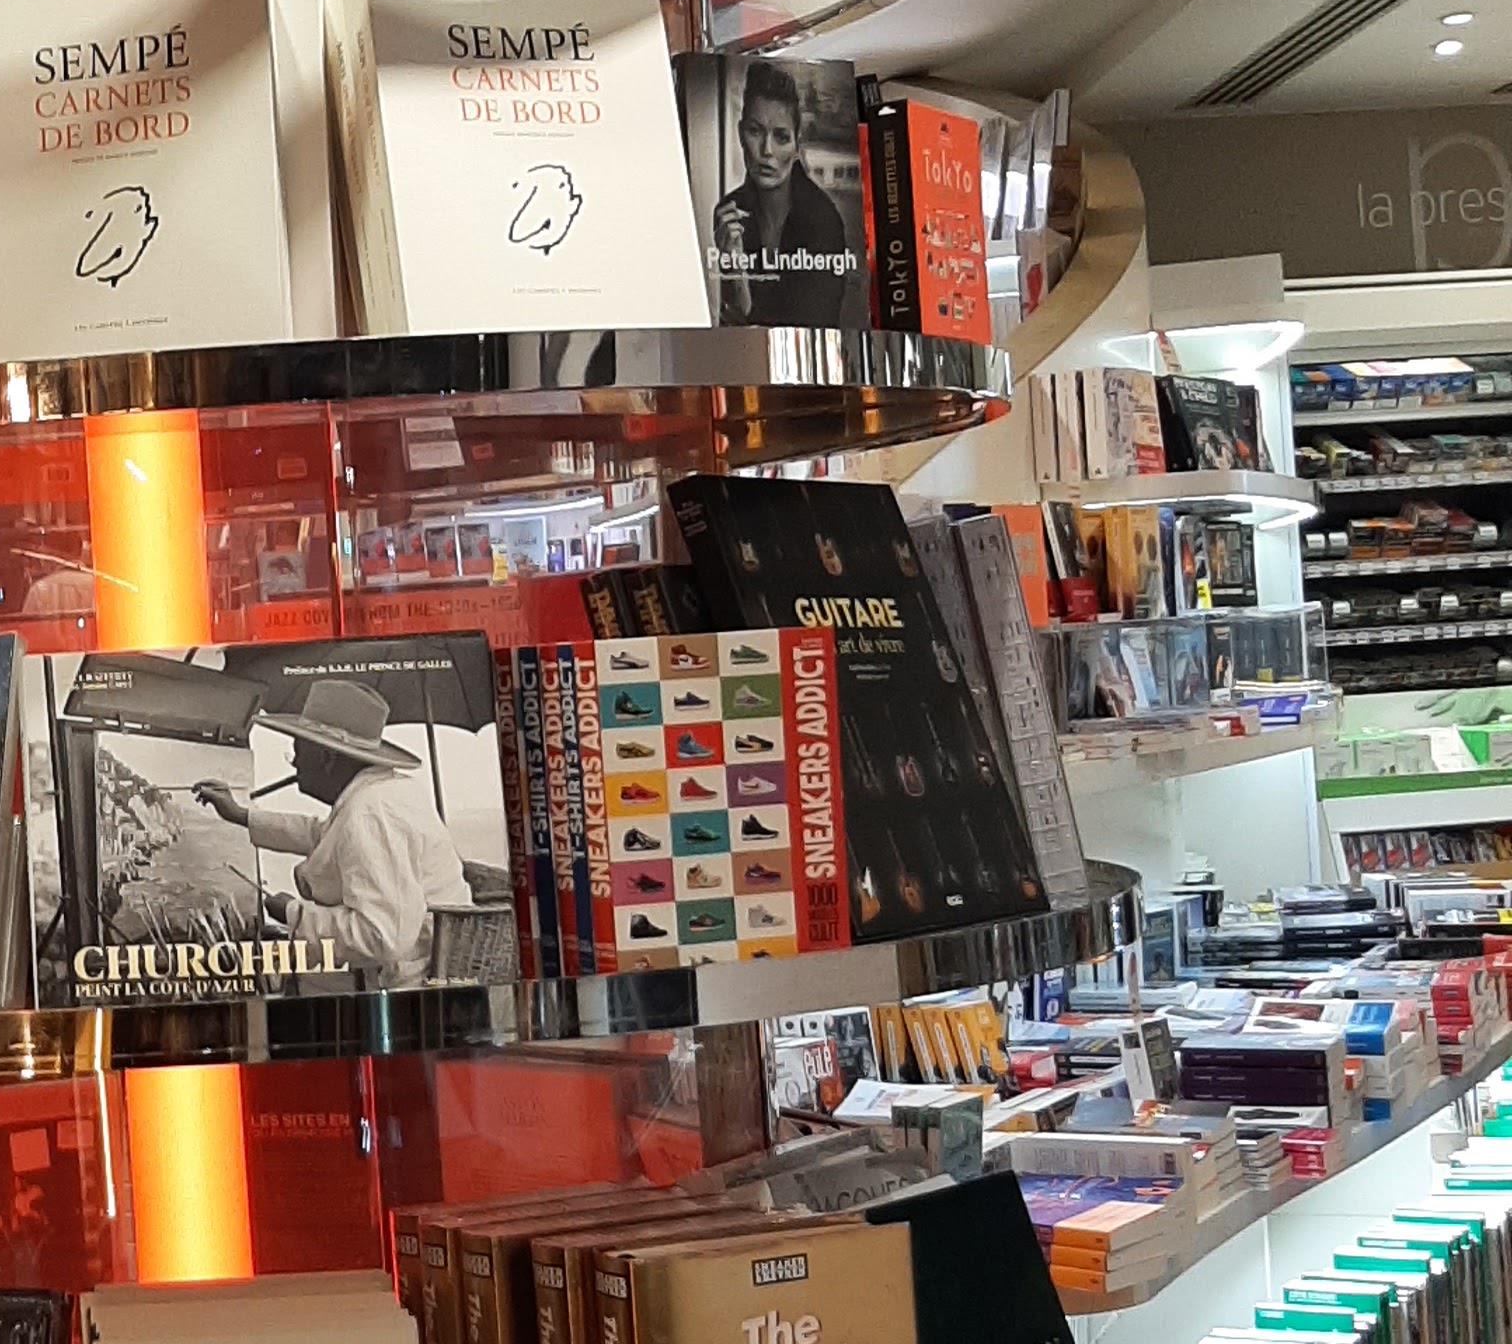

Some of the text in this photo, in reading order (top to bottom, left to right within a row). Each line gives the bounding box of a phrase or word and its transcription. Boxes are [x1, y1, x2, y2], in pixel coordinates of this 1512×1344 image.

[34, 25, 190, 85] SEMPÉ
[448, 22, 596, 63] SEMPÉ
[35, 75, 192, 120] CARNETS
[451, 65, 600, 94] CARNETS
[39, 111, 190, 154] DE BORD
[460, 97, 601, 125] DE BORD
[1355, 183, 1393, 228] la
[708, 246, 857, 277] Peter Lindbergh
[794, 596, 904, 629] GUITARE
[792, 647, 830, 738] ADDICT
[494, 661, 529, 889] SNEAKERS ADDICT
[519, 658, 551, 856] T-SHIRTS ADDICT
[540, 657, 575, 891] SNEAKERS ADDICT
[558, 656, 586, 858] T-SHIRTS ADDICT
[573, 655, 612, 899] SNEAKERS ADDICT
[797, 742, 836, 879] SNEAKERS
[73, 937, 351, 982] CHURCHILL
[75, 982, 122, 999] PEINT
[125, 981, 148, 997] LA
[196, 979, 257, 995] D'AZUR
[466, 1291, 484, 1344] The
